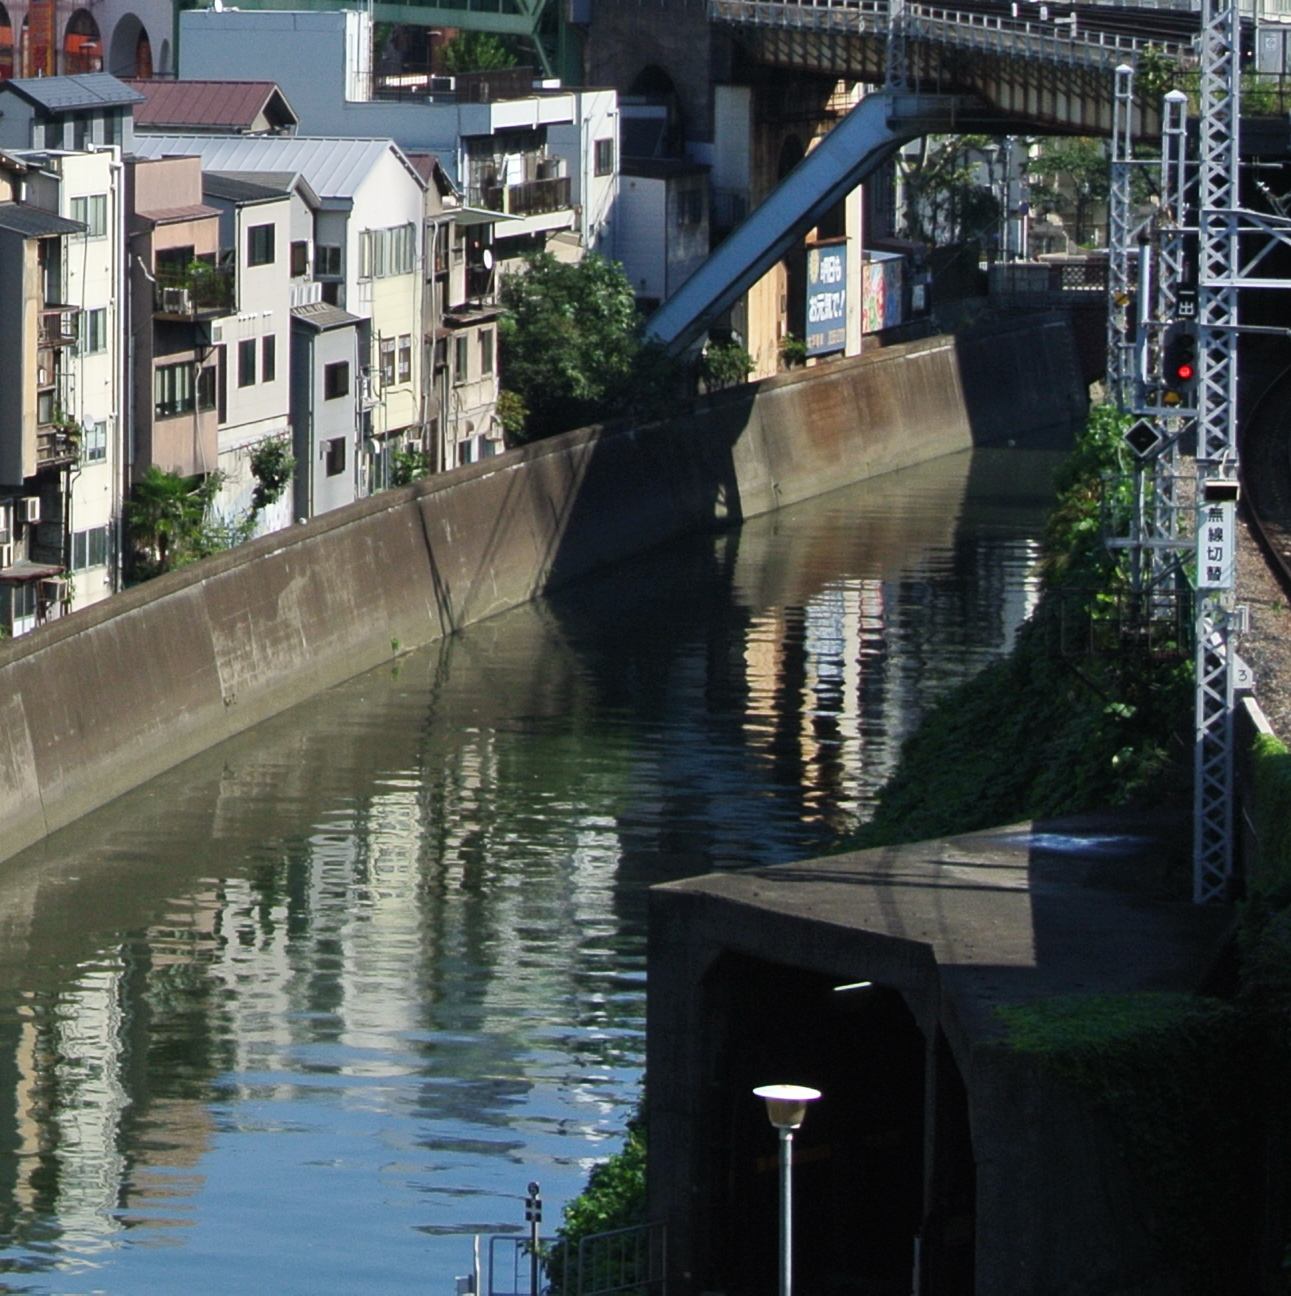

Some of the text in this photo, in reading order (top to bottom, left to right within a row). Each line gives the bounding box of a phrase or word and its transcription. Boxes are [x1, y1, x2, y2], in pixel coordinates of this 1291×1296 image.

[1206, 507, 1224, 581] 無線切替
[1237, 669, 1248, 682] 3
